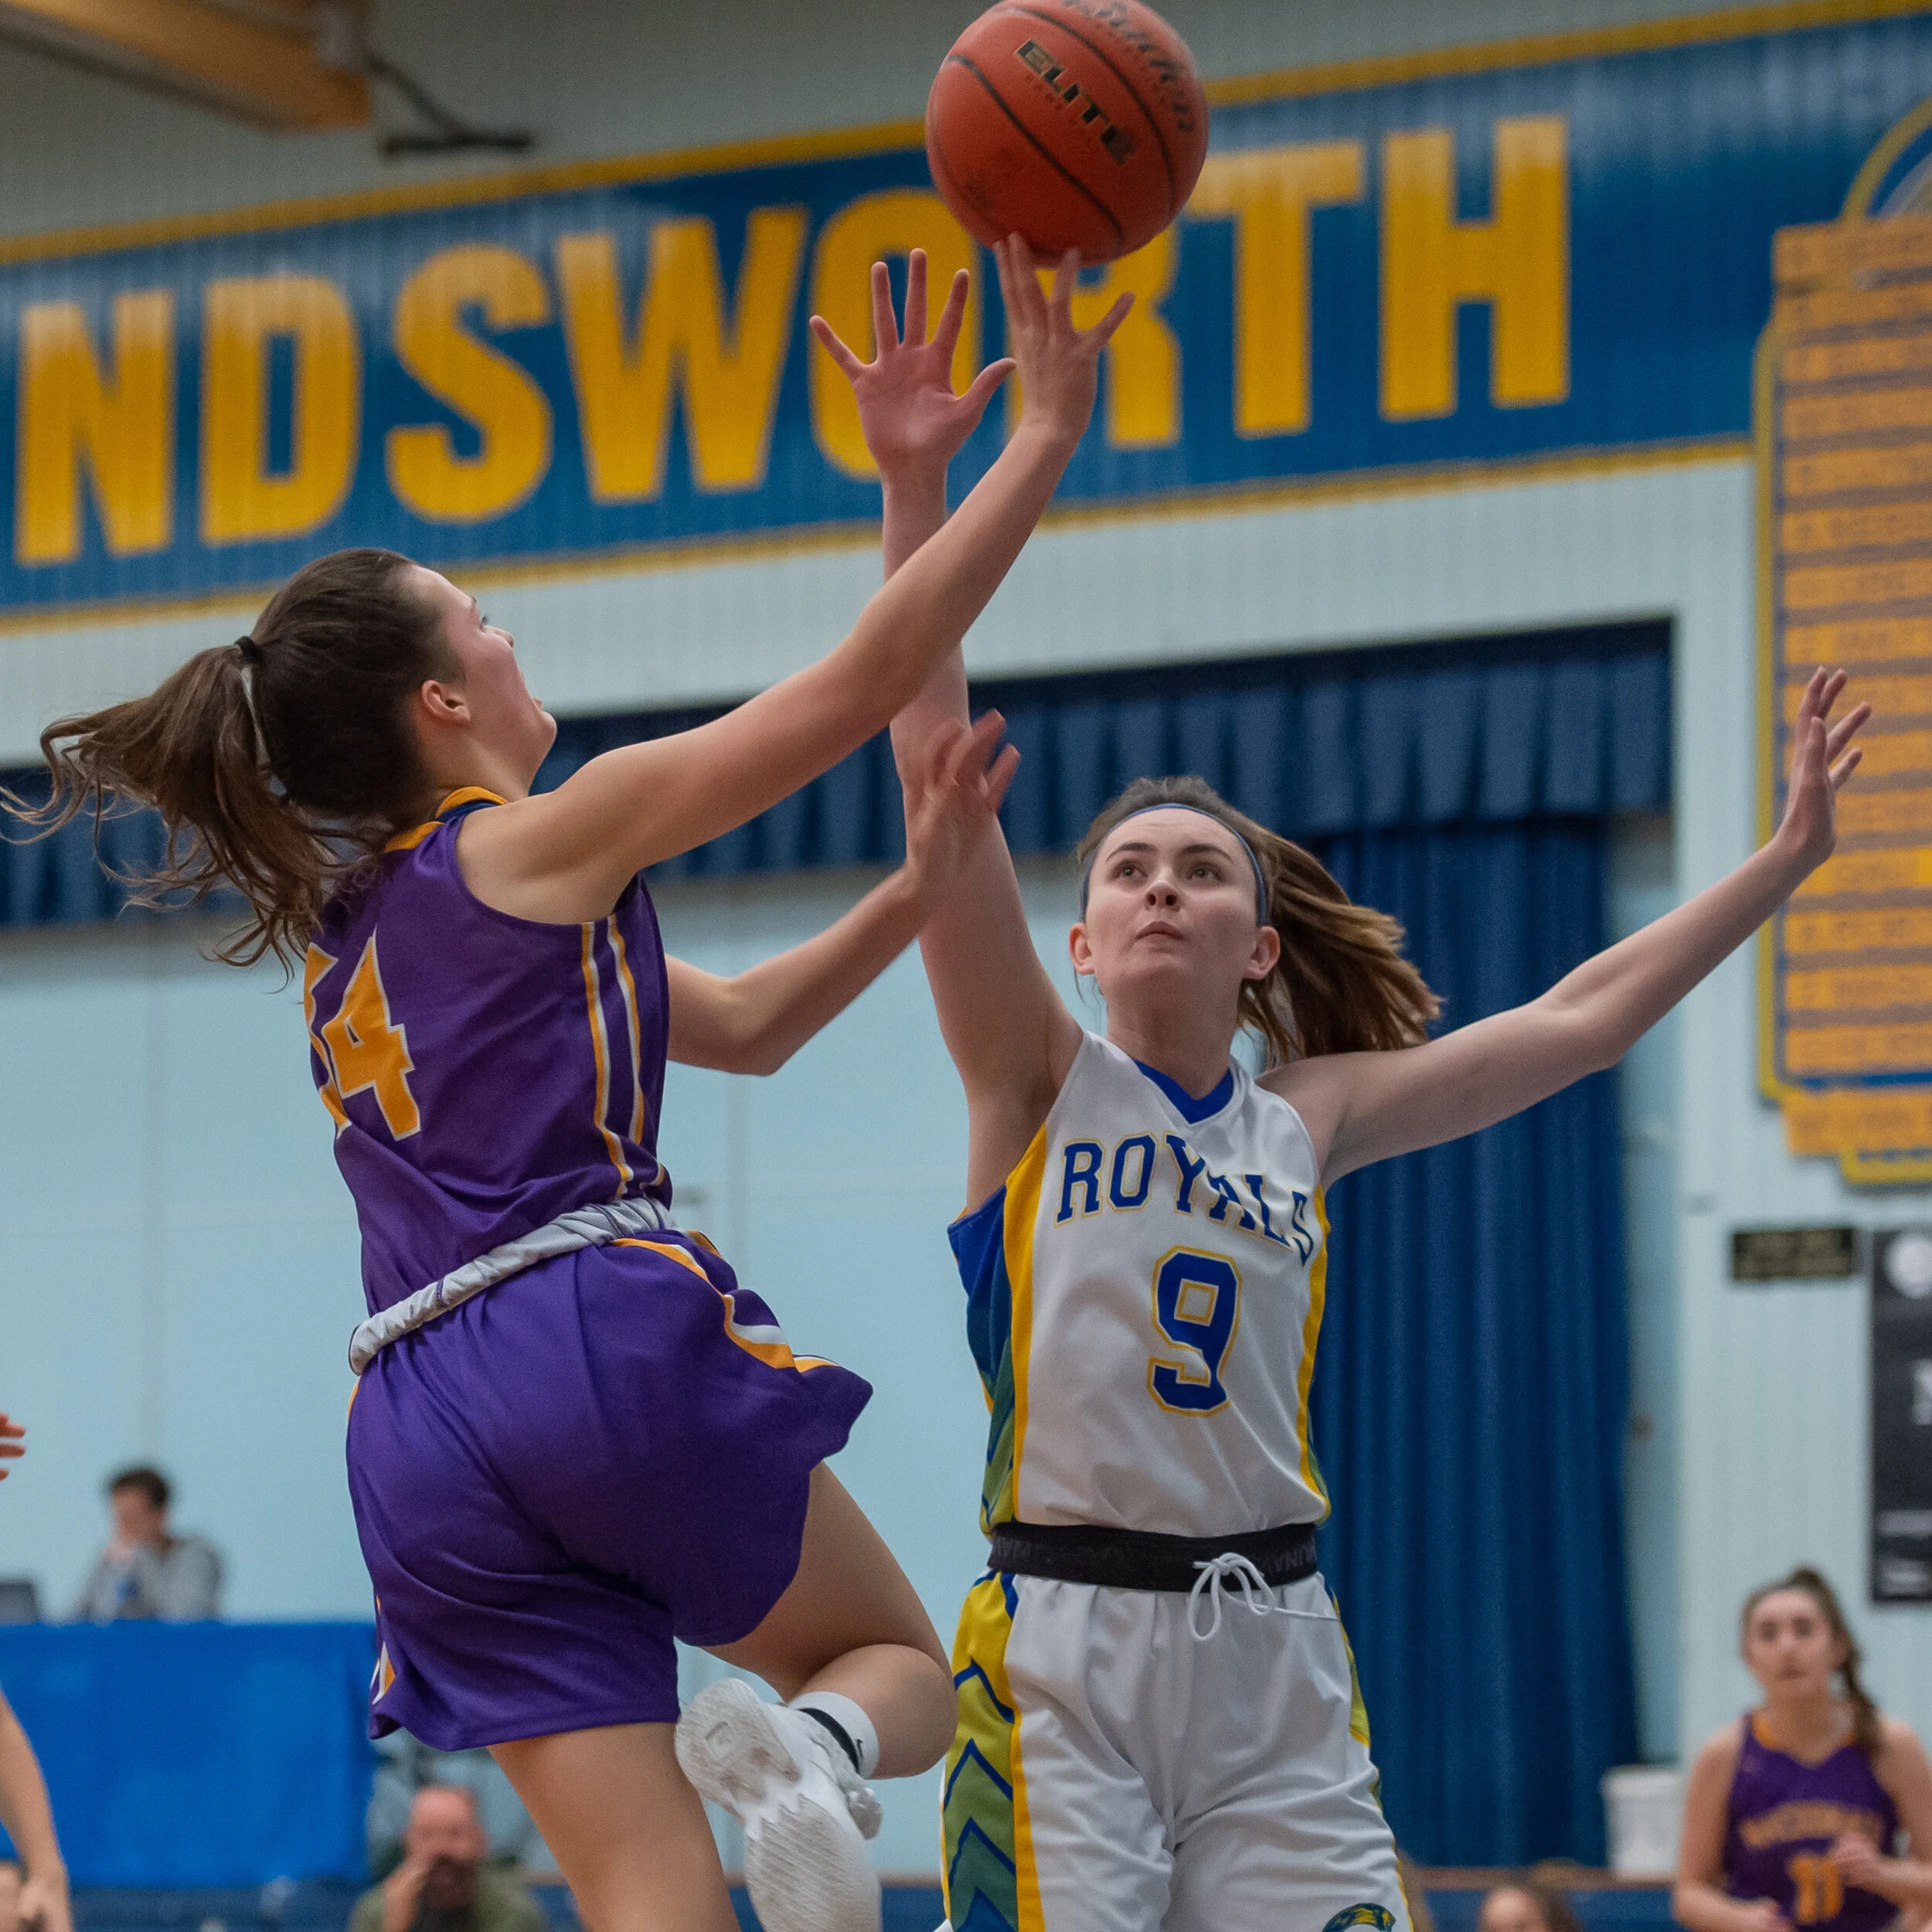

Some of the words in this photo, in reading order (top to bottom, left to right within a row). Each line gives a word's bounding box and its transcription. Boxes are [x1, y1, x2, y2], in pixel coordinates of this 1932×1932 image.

[1014, 36, 1138, 165] ELITE
[1054, 1130, 1315, 1267] ROYALS
[1147, 1245, 1243, 1417] 9
